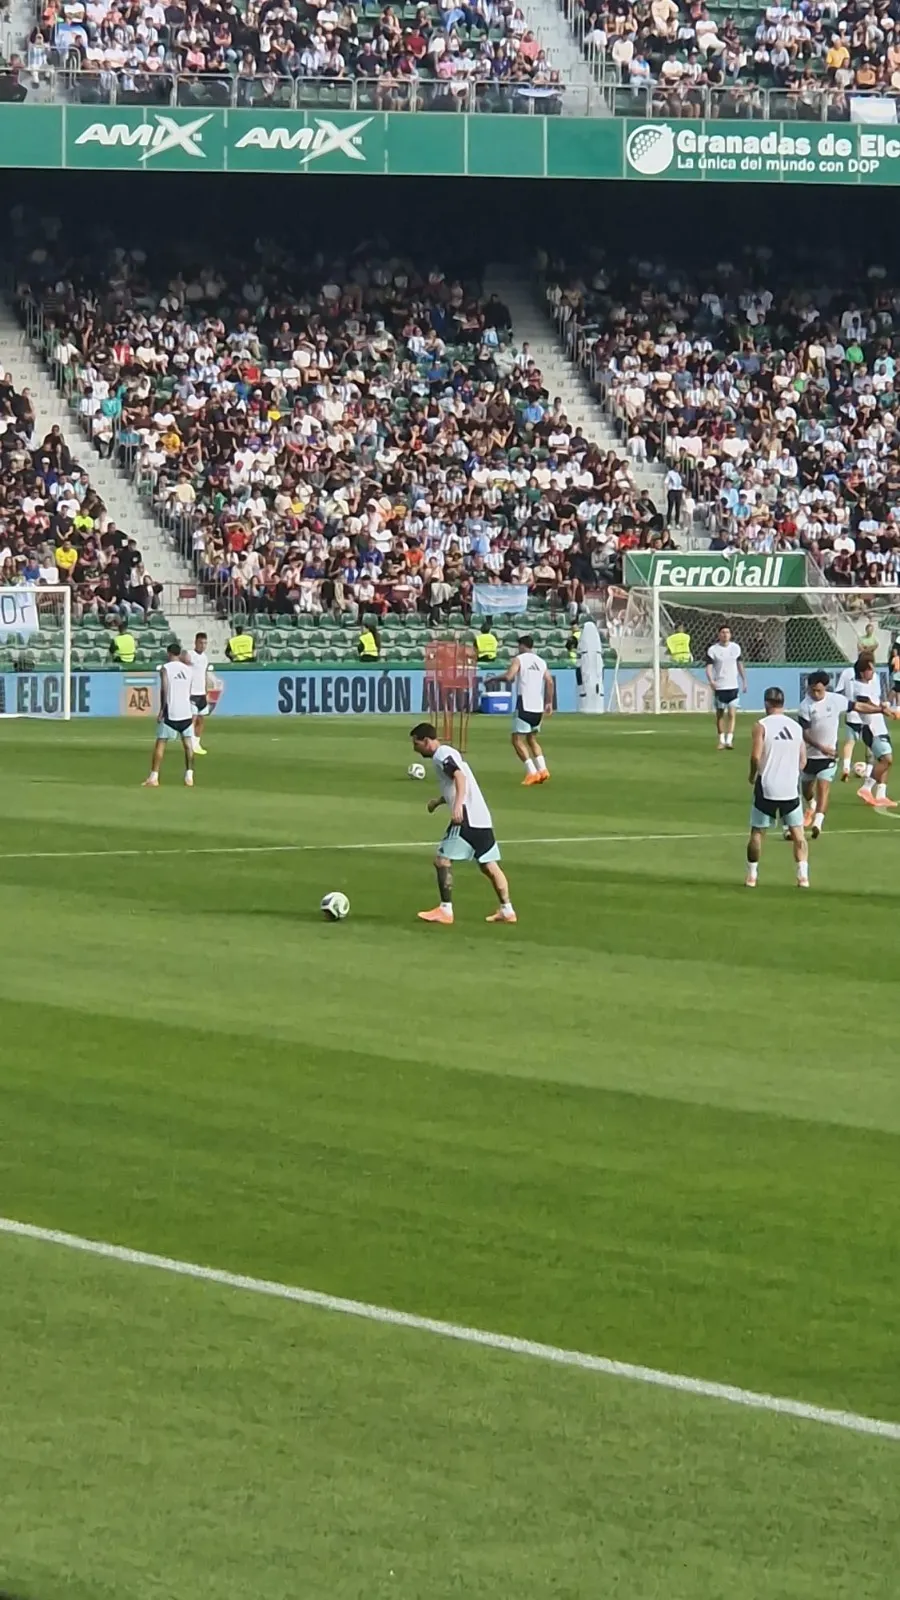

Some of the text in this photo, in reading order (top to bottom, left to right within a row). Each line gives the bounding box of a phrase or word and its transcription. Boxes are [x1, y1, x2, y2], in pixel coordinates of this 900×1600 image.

[677, 130, 811, 157] Granadas
[818, 134, 852, 157] de
[677, 155, 880, 173] La única del mundo con DOP
[653, 556, 783, 587] Ferrotall
[278, 669, 411, 713] SELECCIÓN
